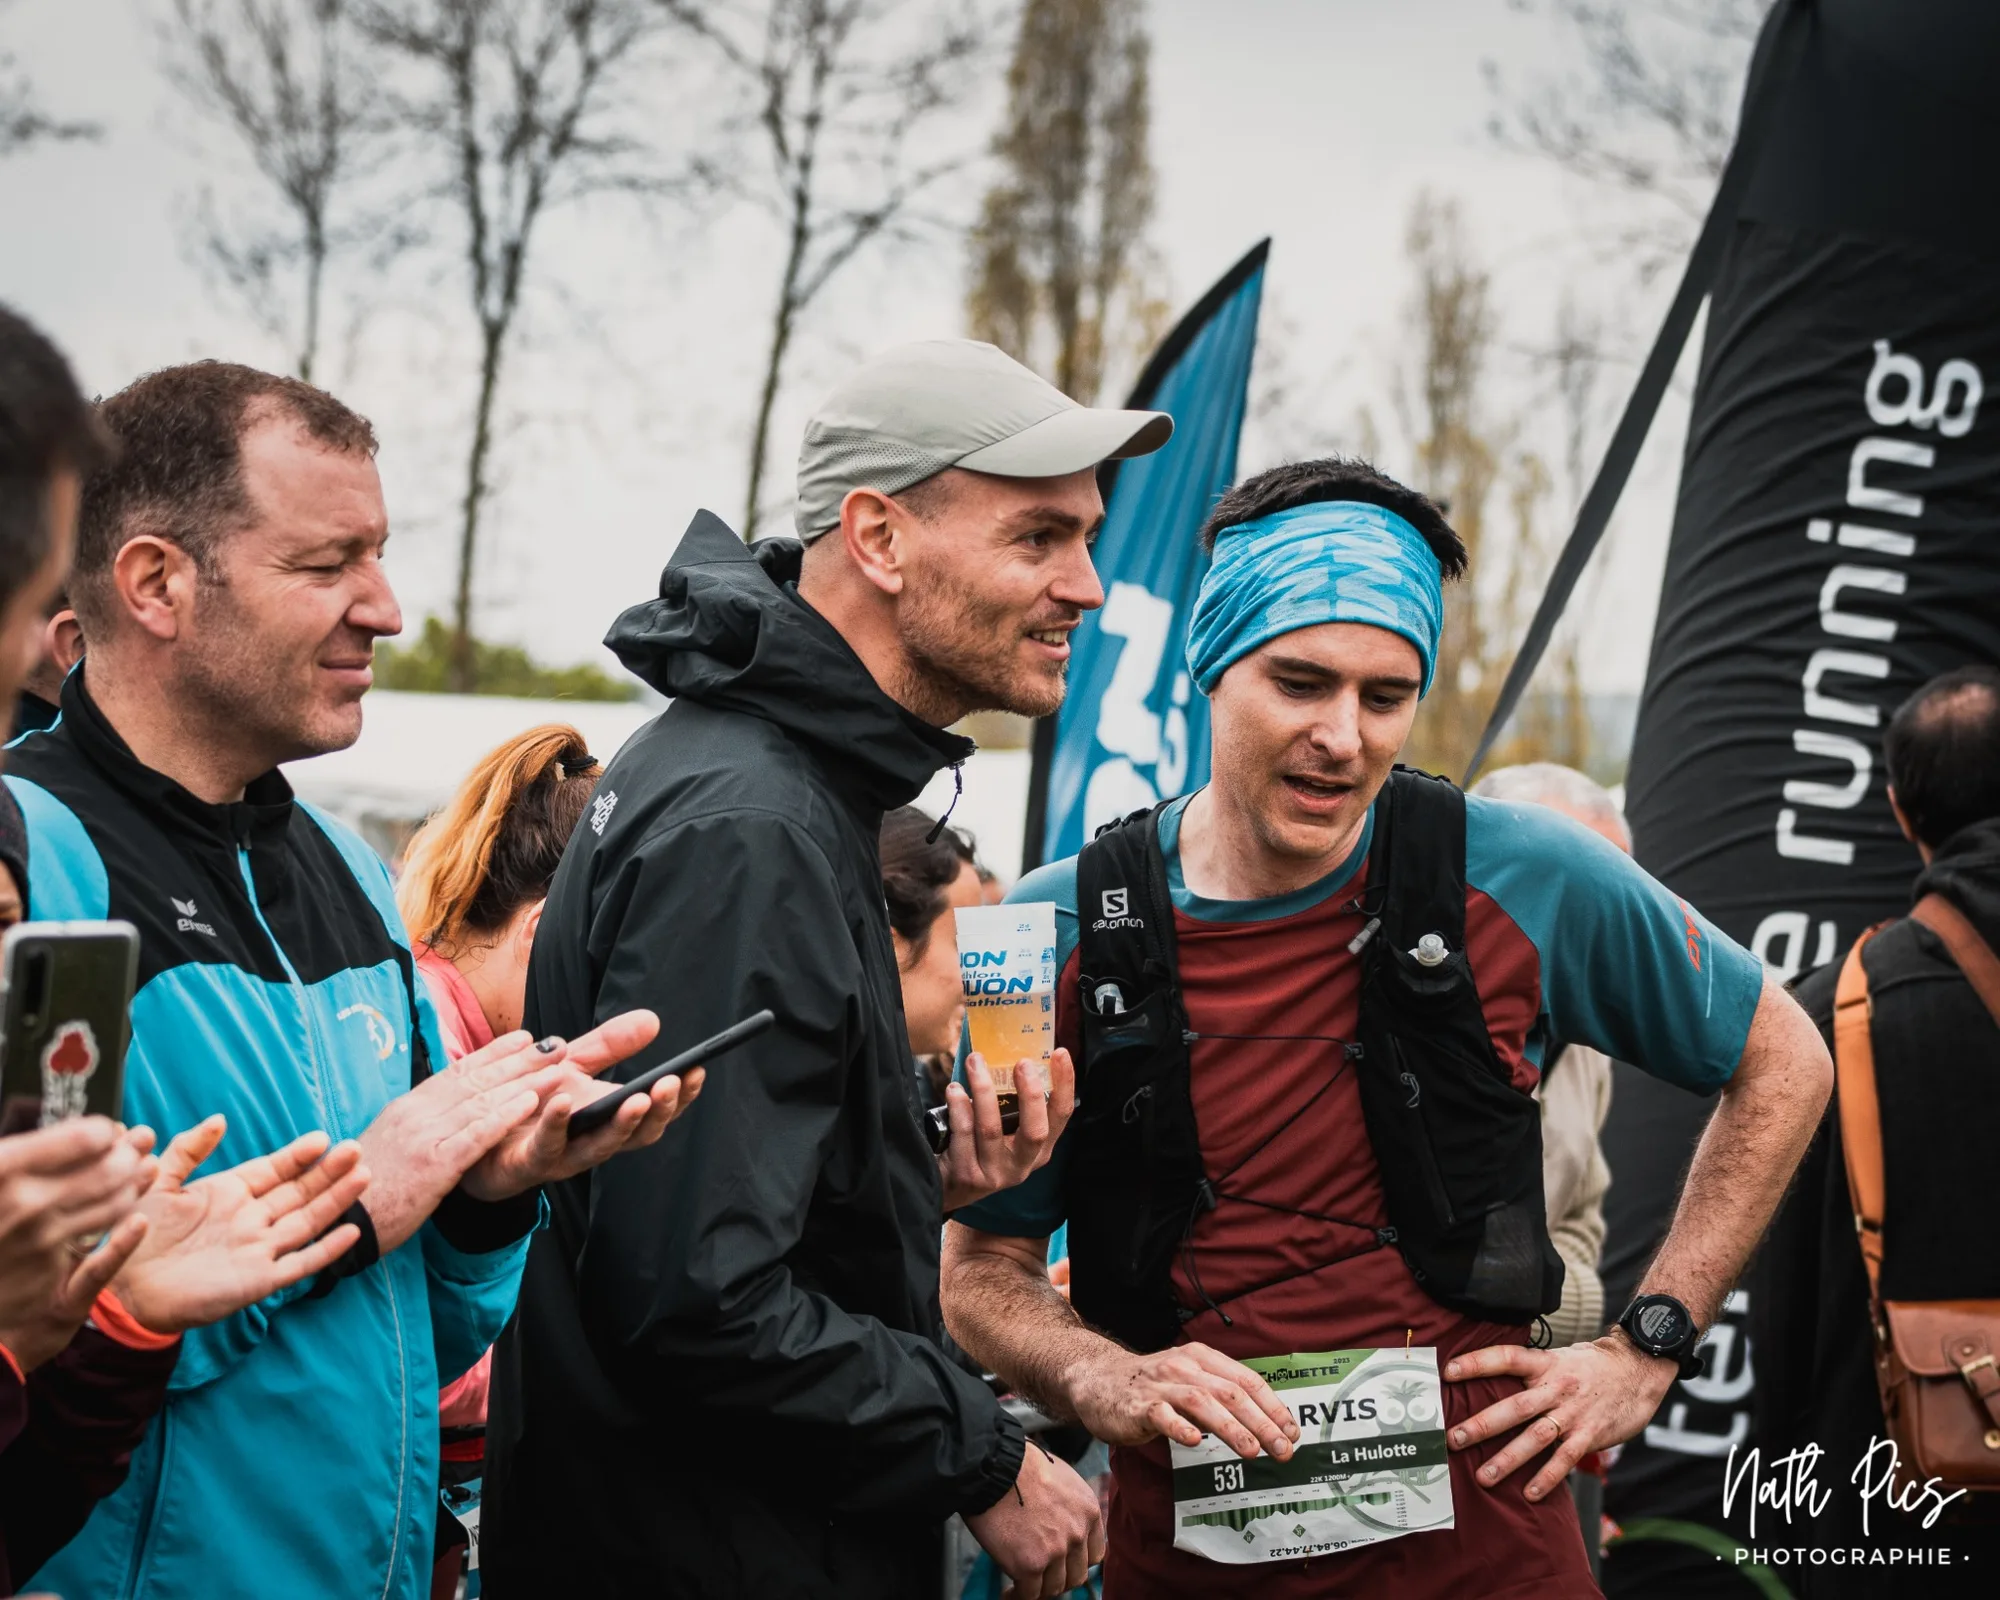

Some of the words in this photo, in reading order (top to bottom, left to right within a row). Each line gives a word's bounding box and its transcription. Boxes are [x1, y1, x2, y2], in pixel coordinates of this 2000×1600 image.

[1776, 339, 1984, 864] running
[1092, 917, 1144, 932] salomon
[1750, 911, 1837, 987] e
[1287, 1398, 1377, 1427] RVIS
[1331, 1450, 1350, 1464] La
[1354, 1443, 1417, 1462] Hulotte
[1213, 1463, 1244, 1492] 531
[1310, 1475, 1323, 1483] 22K
[1269, 1540, 1348, 1557] 06.84.77.44.22
